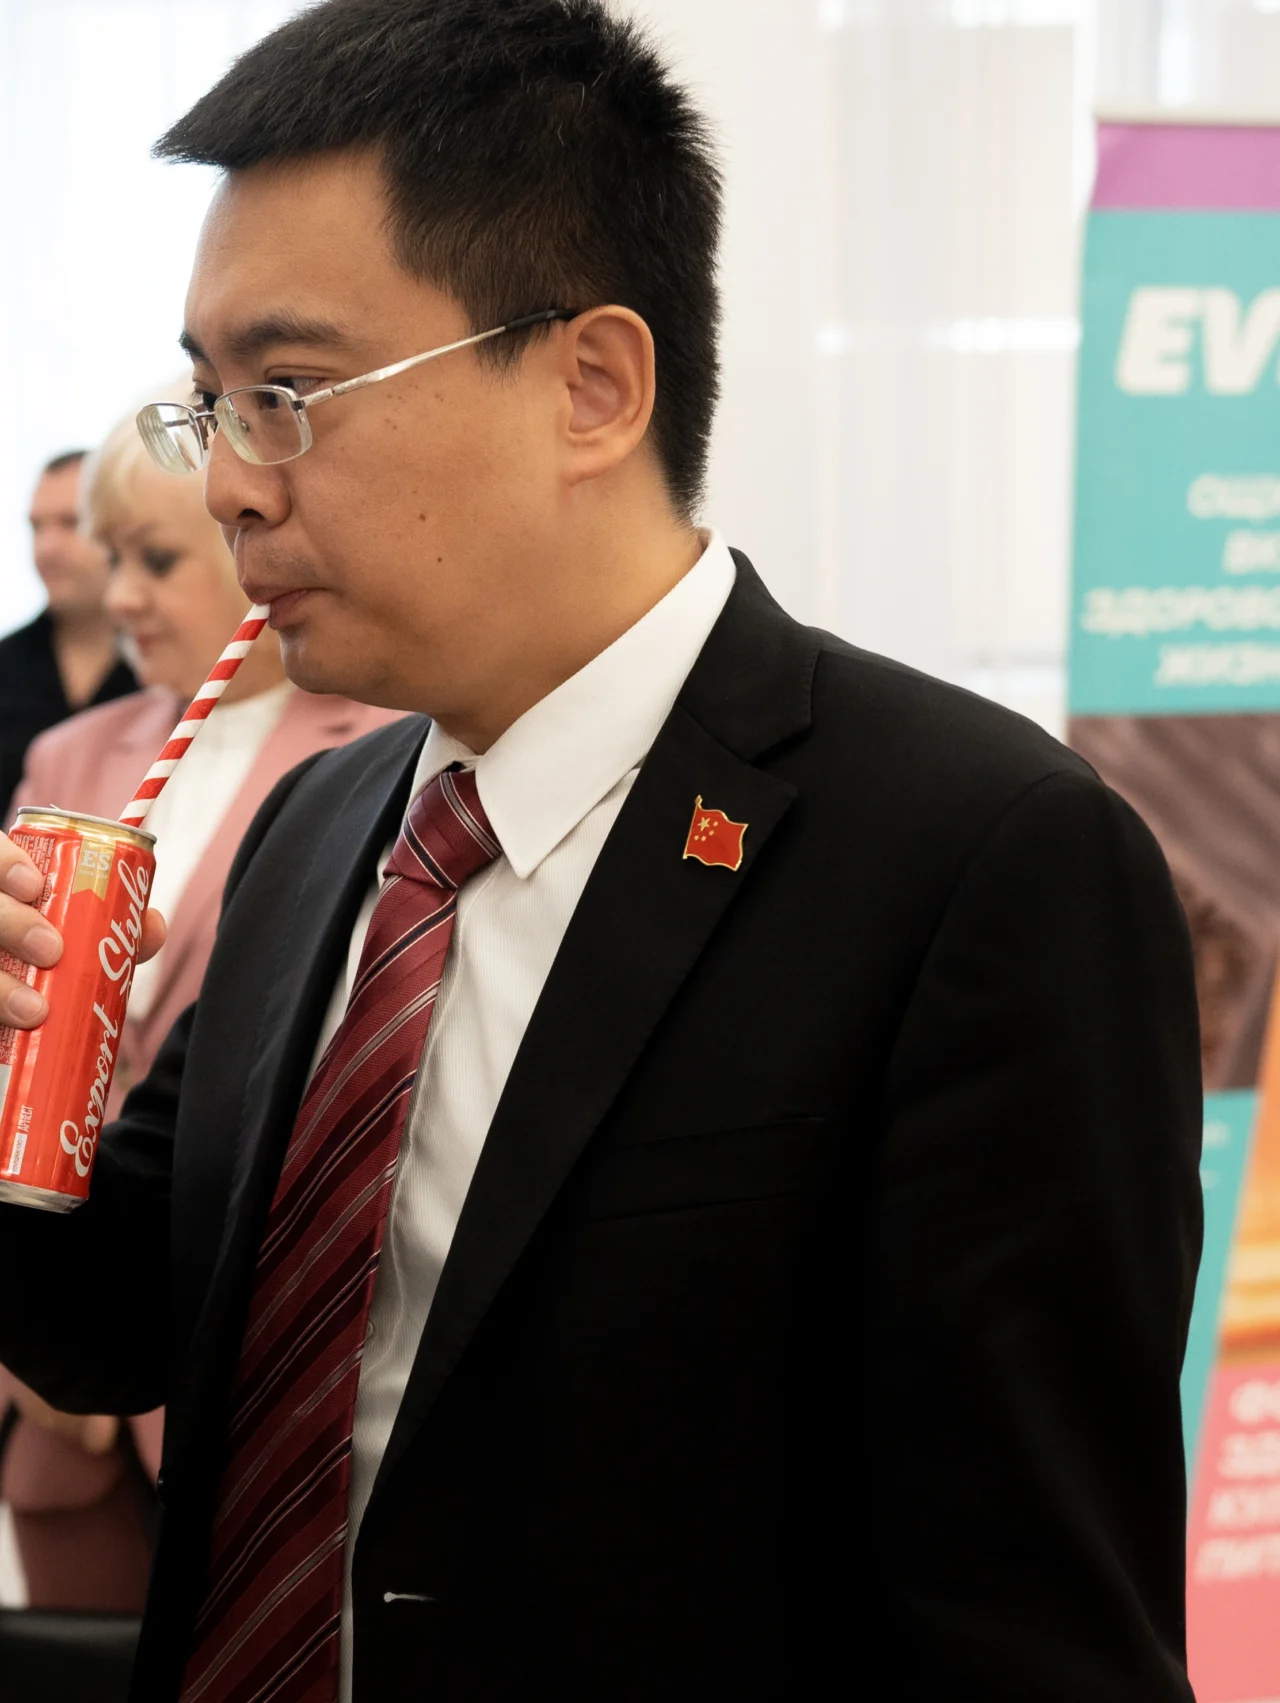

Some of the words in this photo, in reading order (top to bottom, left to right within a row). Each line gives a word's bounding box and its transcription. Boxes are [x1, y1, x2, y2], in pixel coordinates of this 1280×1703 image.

[1116, 286, 1280, 395] EV
[80, 849, 111, 872] ES
[60, 1002, 118, 1177] Export
[98, 859, 149, 997] Style
